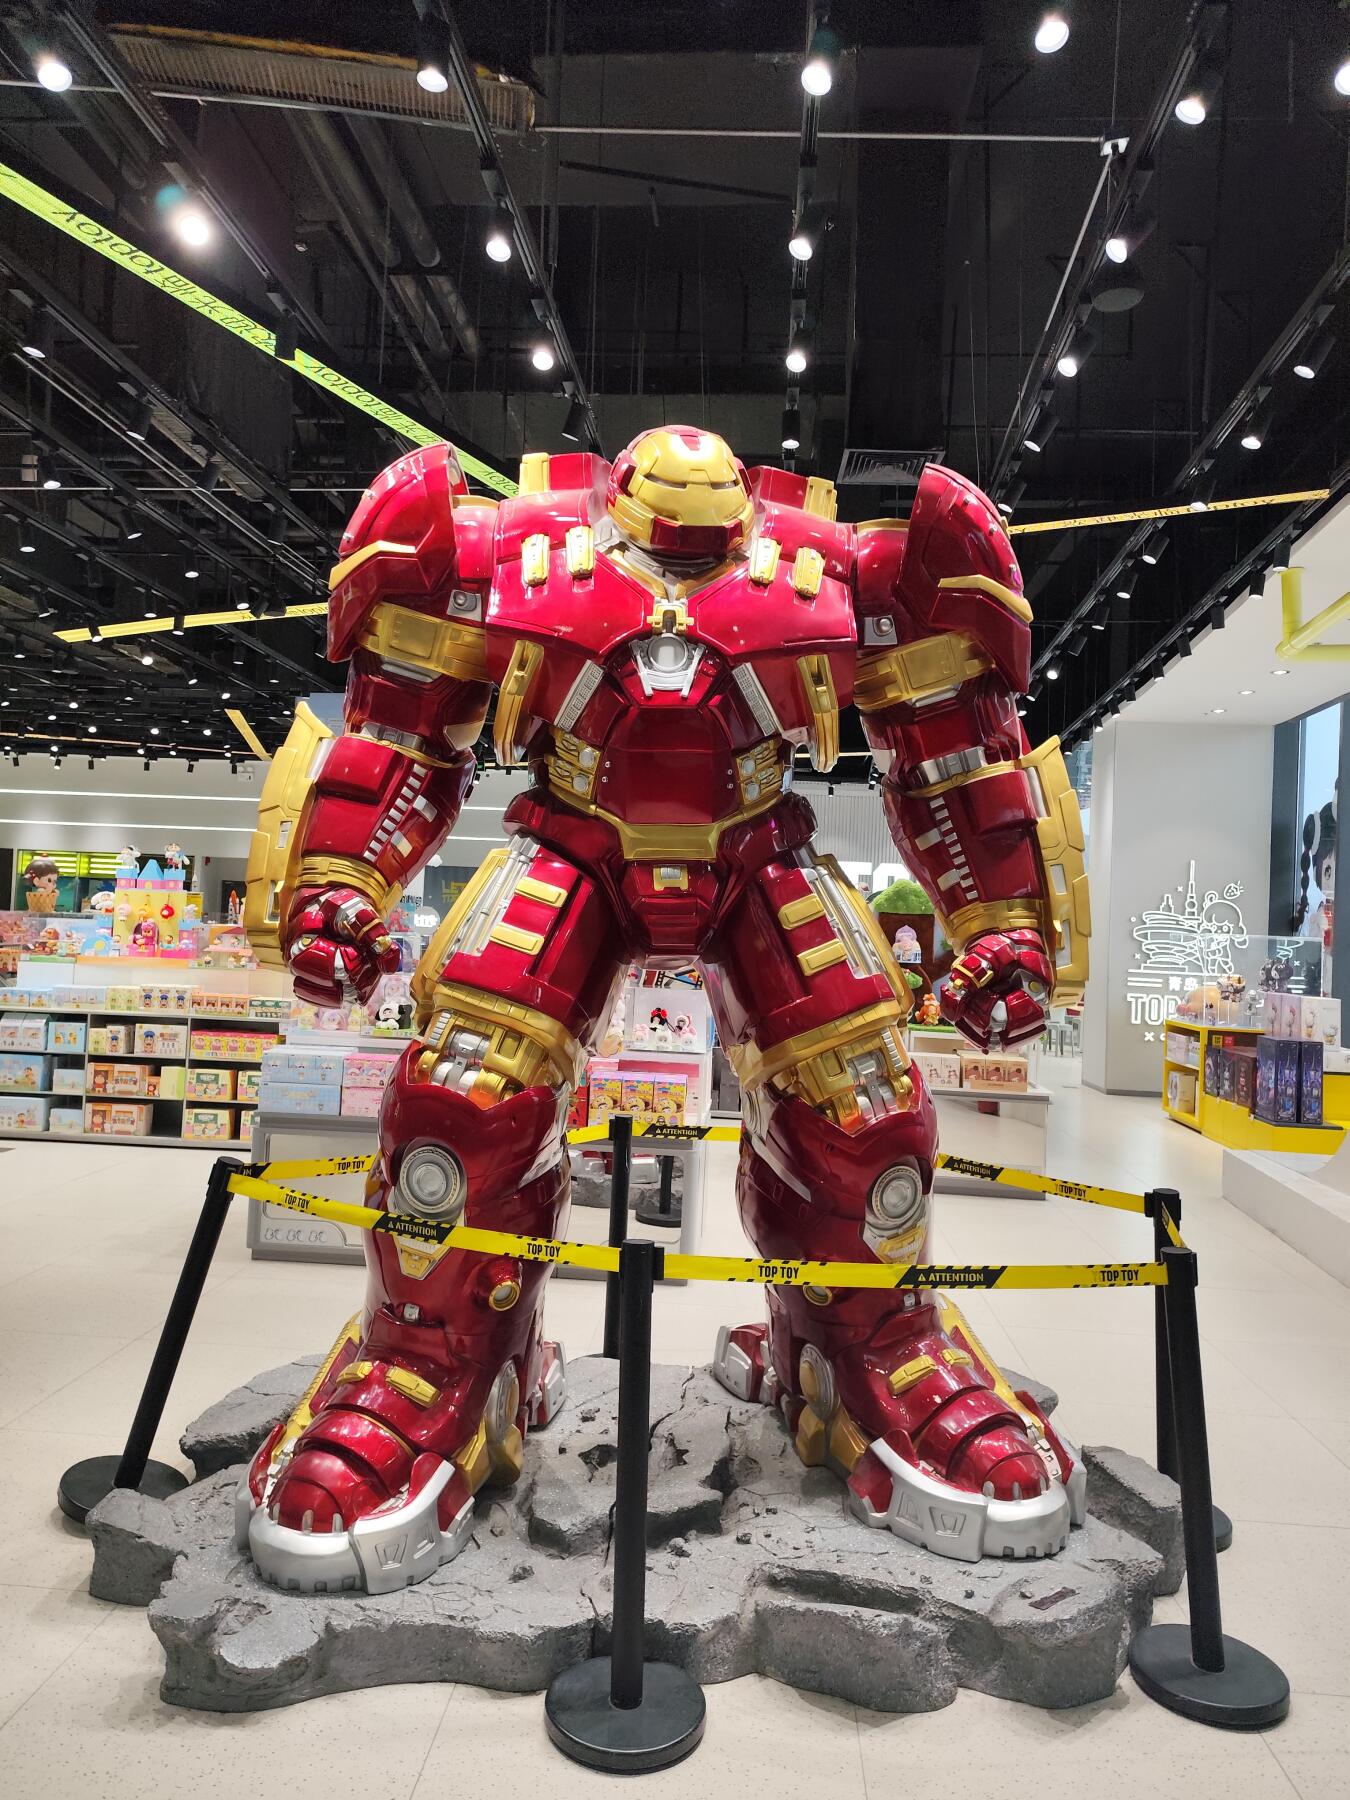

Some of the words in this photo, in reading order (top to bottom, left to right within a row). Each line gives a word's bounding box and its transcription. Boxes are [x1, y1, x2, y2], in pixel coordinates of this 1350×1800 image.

[662, 1128, 698, 1136] ATTENTION
[337, 1162, 351, 1171] TOP
[352, 1160, 365, 1169] TOY
[960, 1162, 991, 1175] ATTENTION
[1060, 1185, 1073, 1195] TOP
[1073, 1188, 1087, 1198] TOY
[284, 1193, 297, 1204] TOP
[297, 1197, 310, 1209] TOY
[396, 1222, 437, 1237] ATTENTION
[527, 1242, 543, 1255] TOP
[544, 1245, 561, 1257] TOY
[758, 1265, 778, 1278] TOP
[780, 1266, 799, 1279] TOY
[928, 1272, 984, 1282] ATTENTION
[1100, 1270, 1119, 1282] TOP
[1121, 1269, 1139, 1282] TOY
